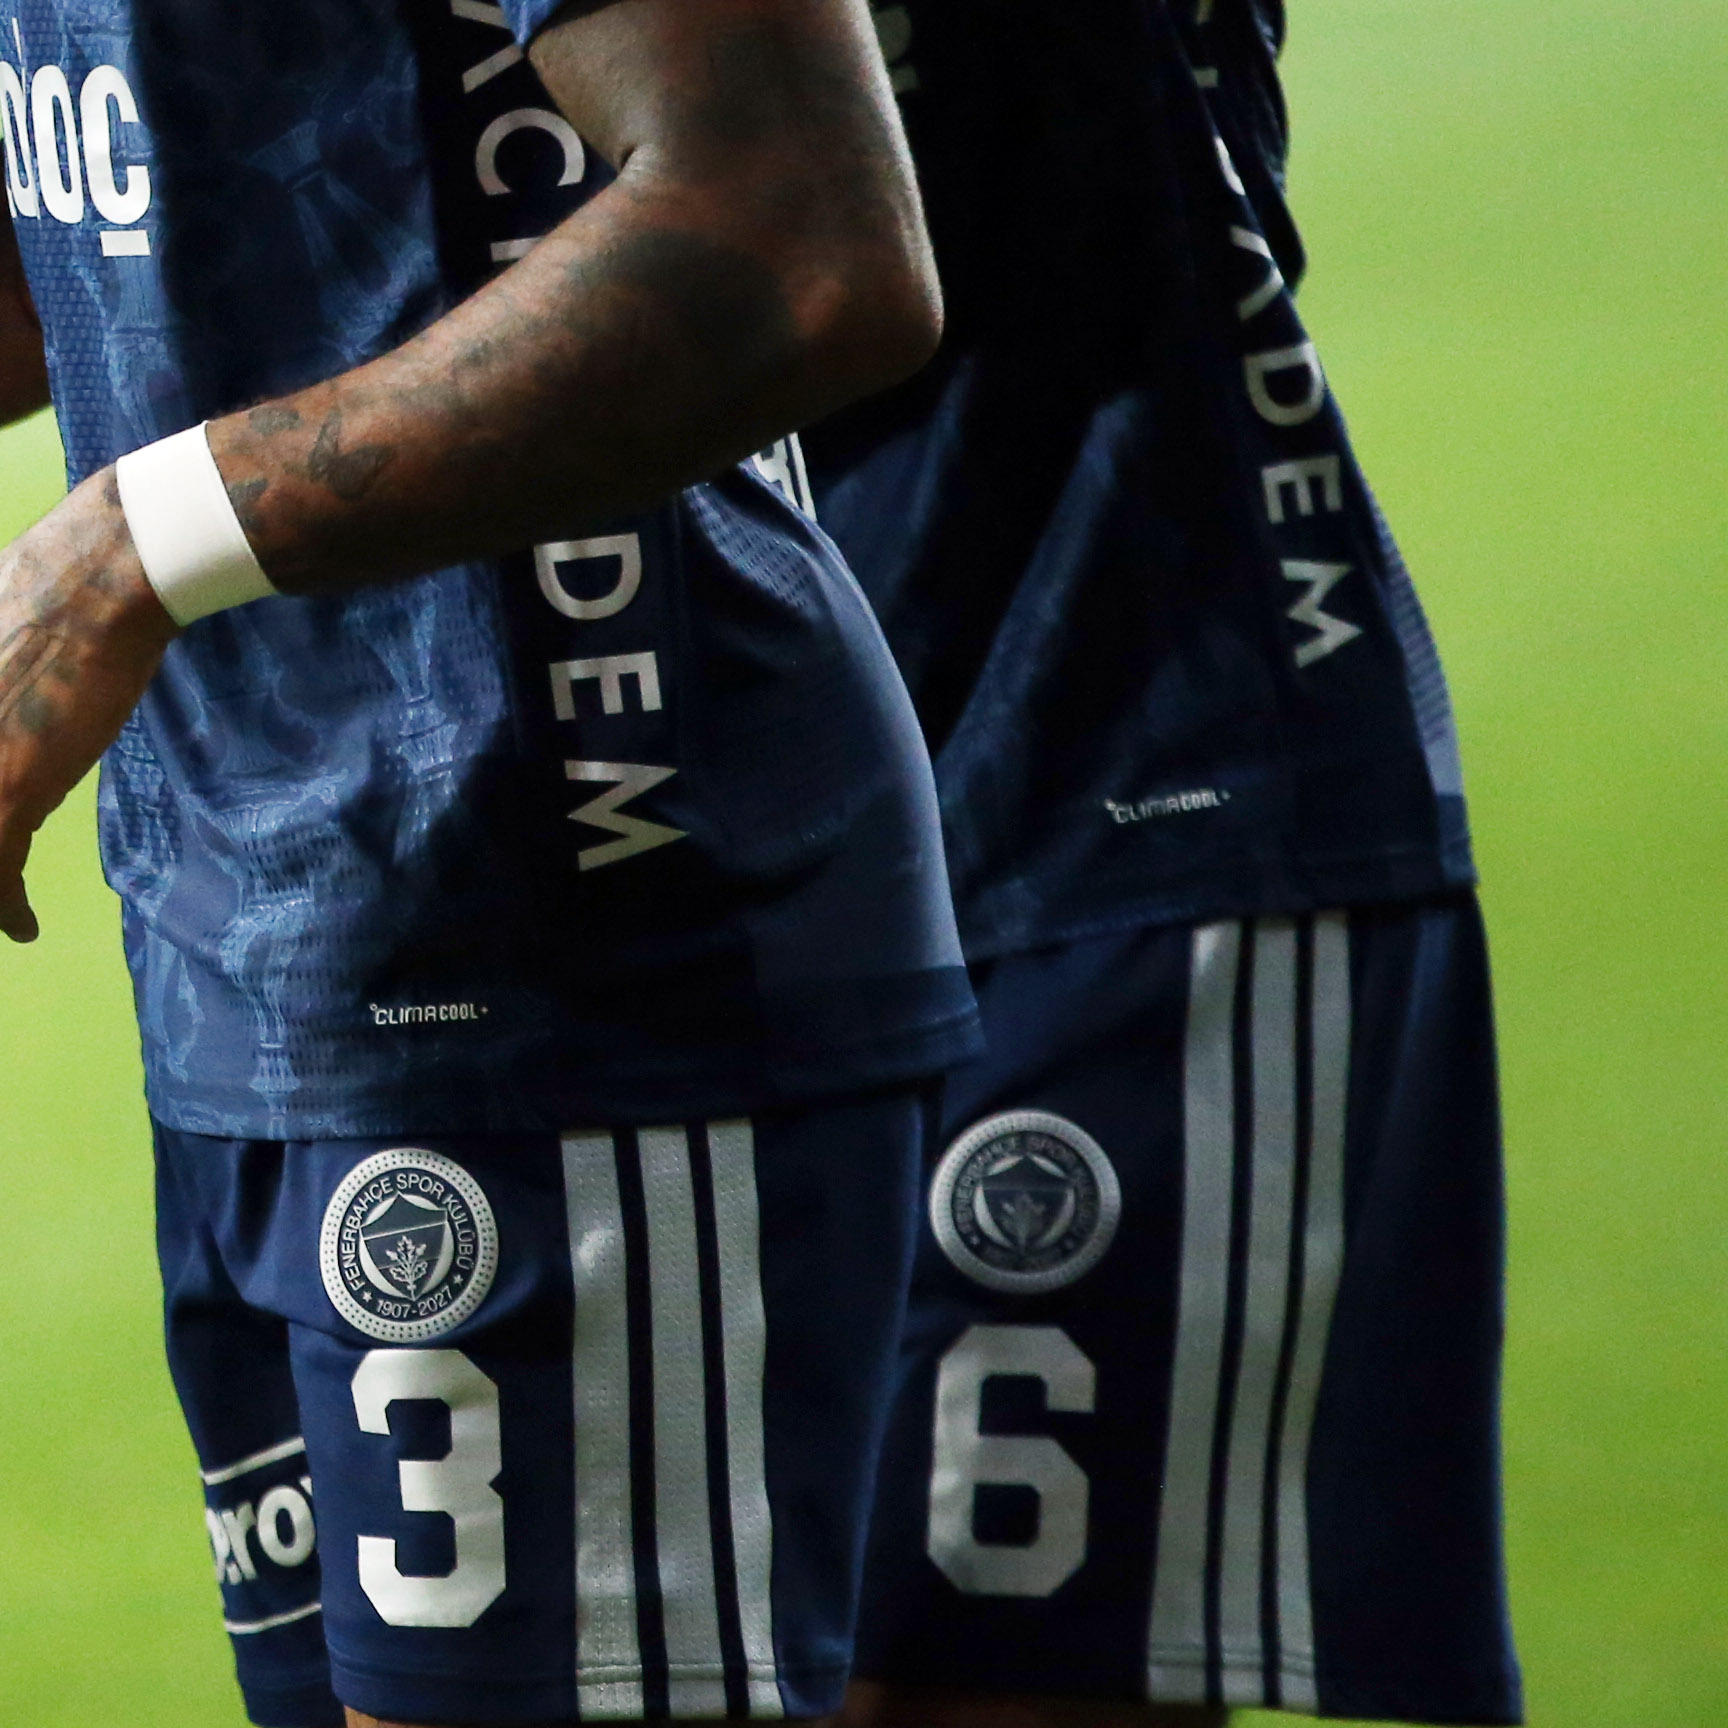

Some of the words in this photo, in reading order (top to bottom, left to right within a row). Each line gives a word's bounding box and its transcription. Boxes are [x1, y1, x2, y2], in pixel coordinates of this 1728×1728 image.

[341, 1177, 394, 1291] FENERBAHÇE
[396, 1173, 446, 1200] SPOR
[443, 1193, 477, 1270] KULÜBÜ
[375, 1285, 454, 1319] 1907-2027
[351, 1348, 507, 1628] 3
[926, 1324, 1096, 1598] 6
